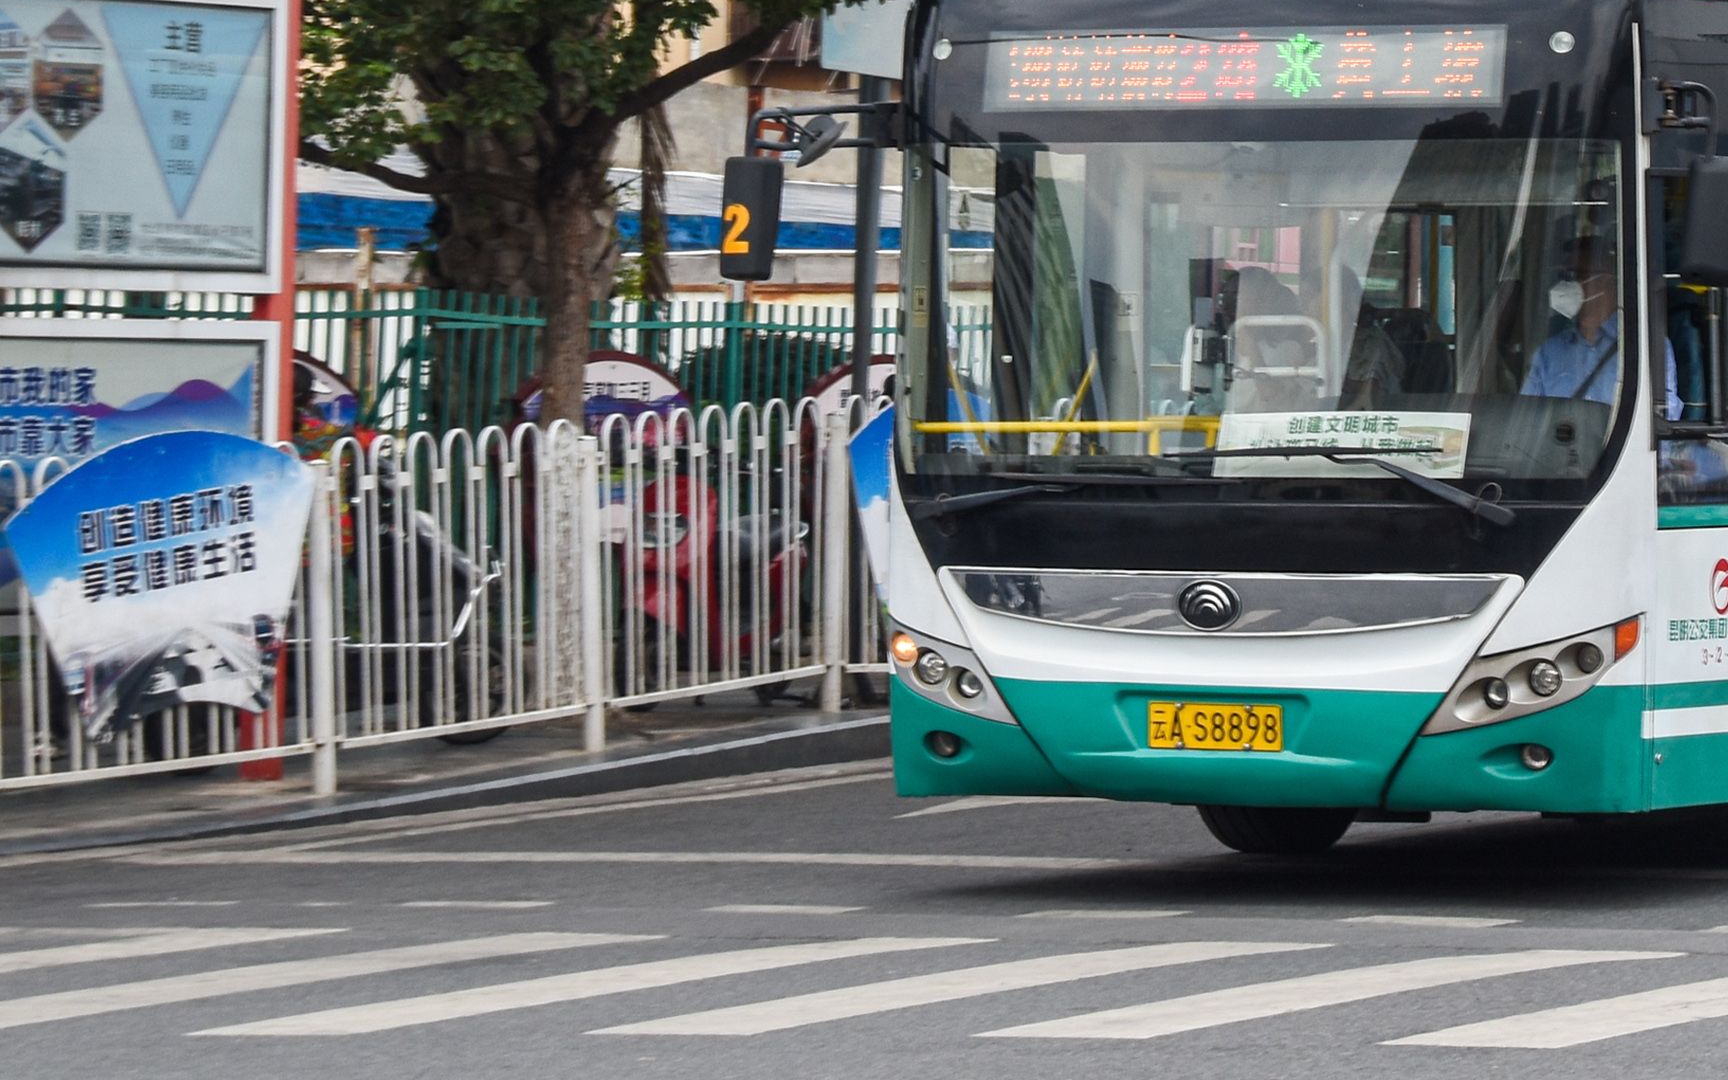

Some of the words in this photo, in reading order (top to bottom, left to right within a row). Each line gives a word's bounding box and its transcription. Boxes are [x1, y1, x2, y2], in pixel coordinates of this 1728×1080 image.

[722, 203, 750, 254] 2
[1289, 415, 1399, 434] 创建文明城市
[77, 484, 254, 555] 创造健康环境
[82, 531, 257, 603] 享受健康生活
